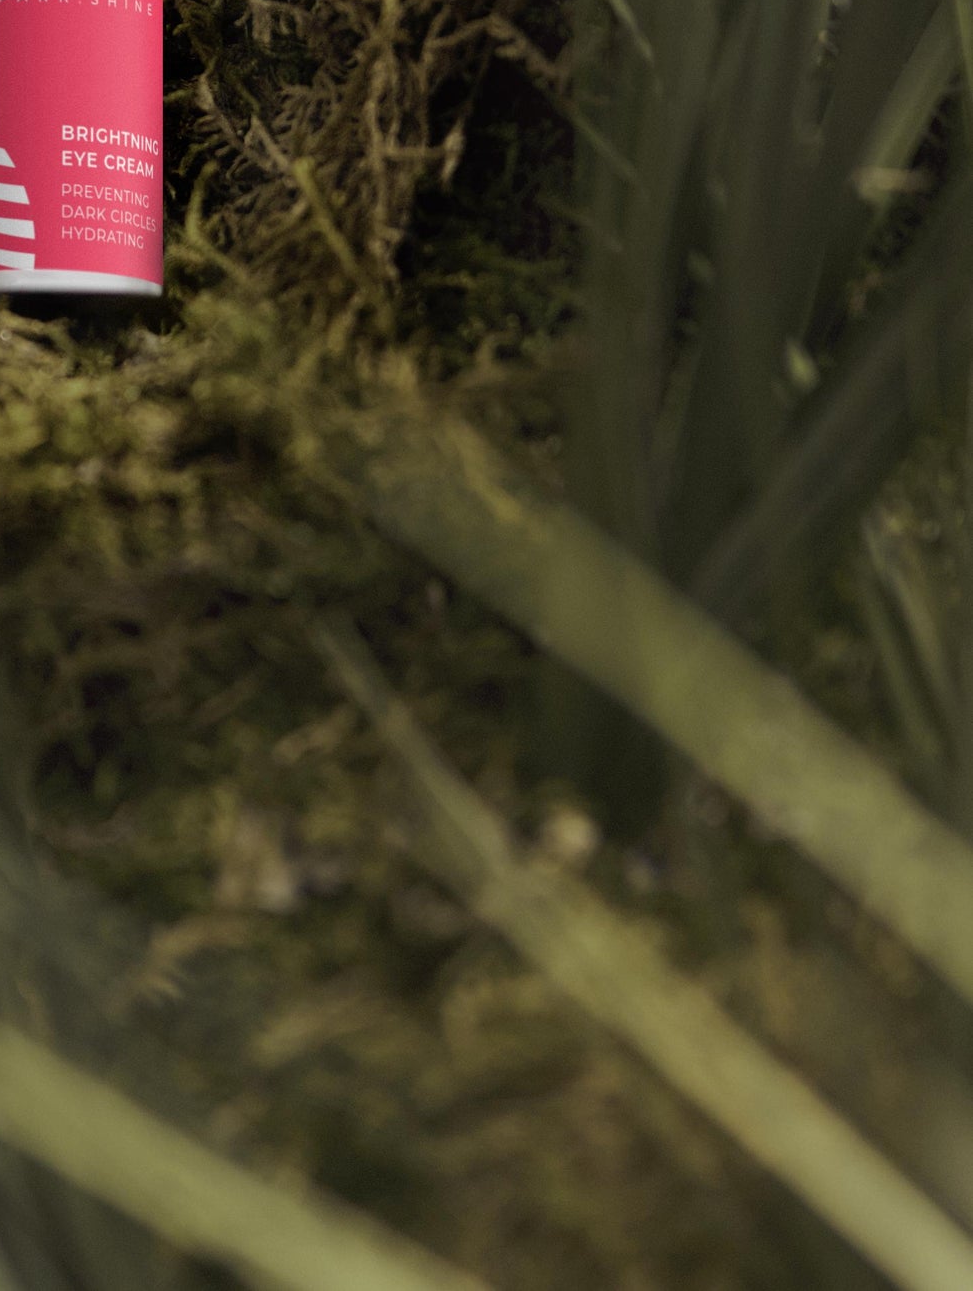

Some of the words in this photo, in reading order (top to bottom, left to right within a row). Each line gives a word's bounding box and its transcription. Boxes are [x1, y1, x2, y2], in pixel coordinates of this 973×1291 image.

[62, 125, 159, 156] BRIGHTNING
[62, 151, 97, 168] EYE
[104, 154, 154, 179] CREAM
[62, 184, 149, 208] PREVENTING
[62, 205, 106, 221] DARK
[111, 209, 156, 232] CIRCLES
[62, 226, 144, 249] HYDRATING
